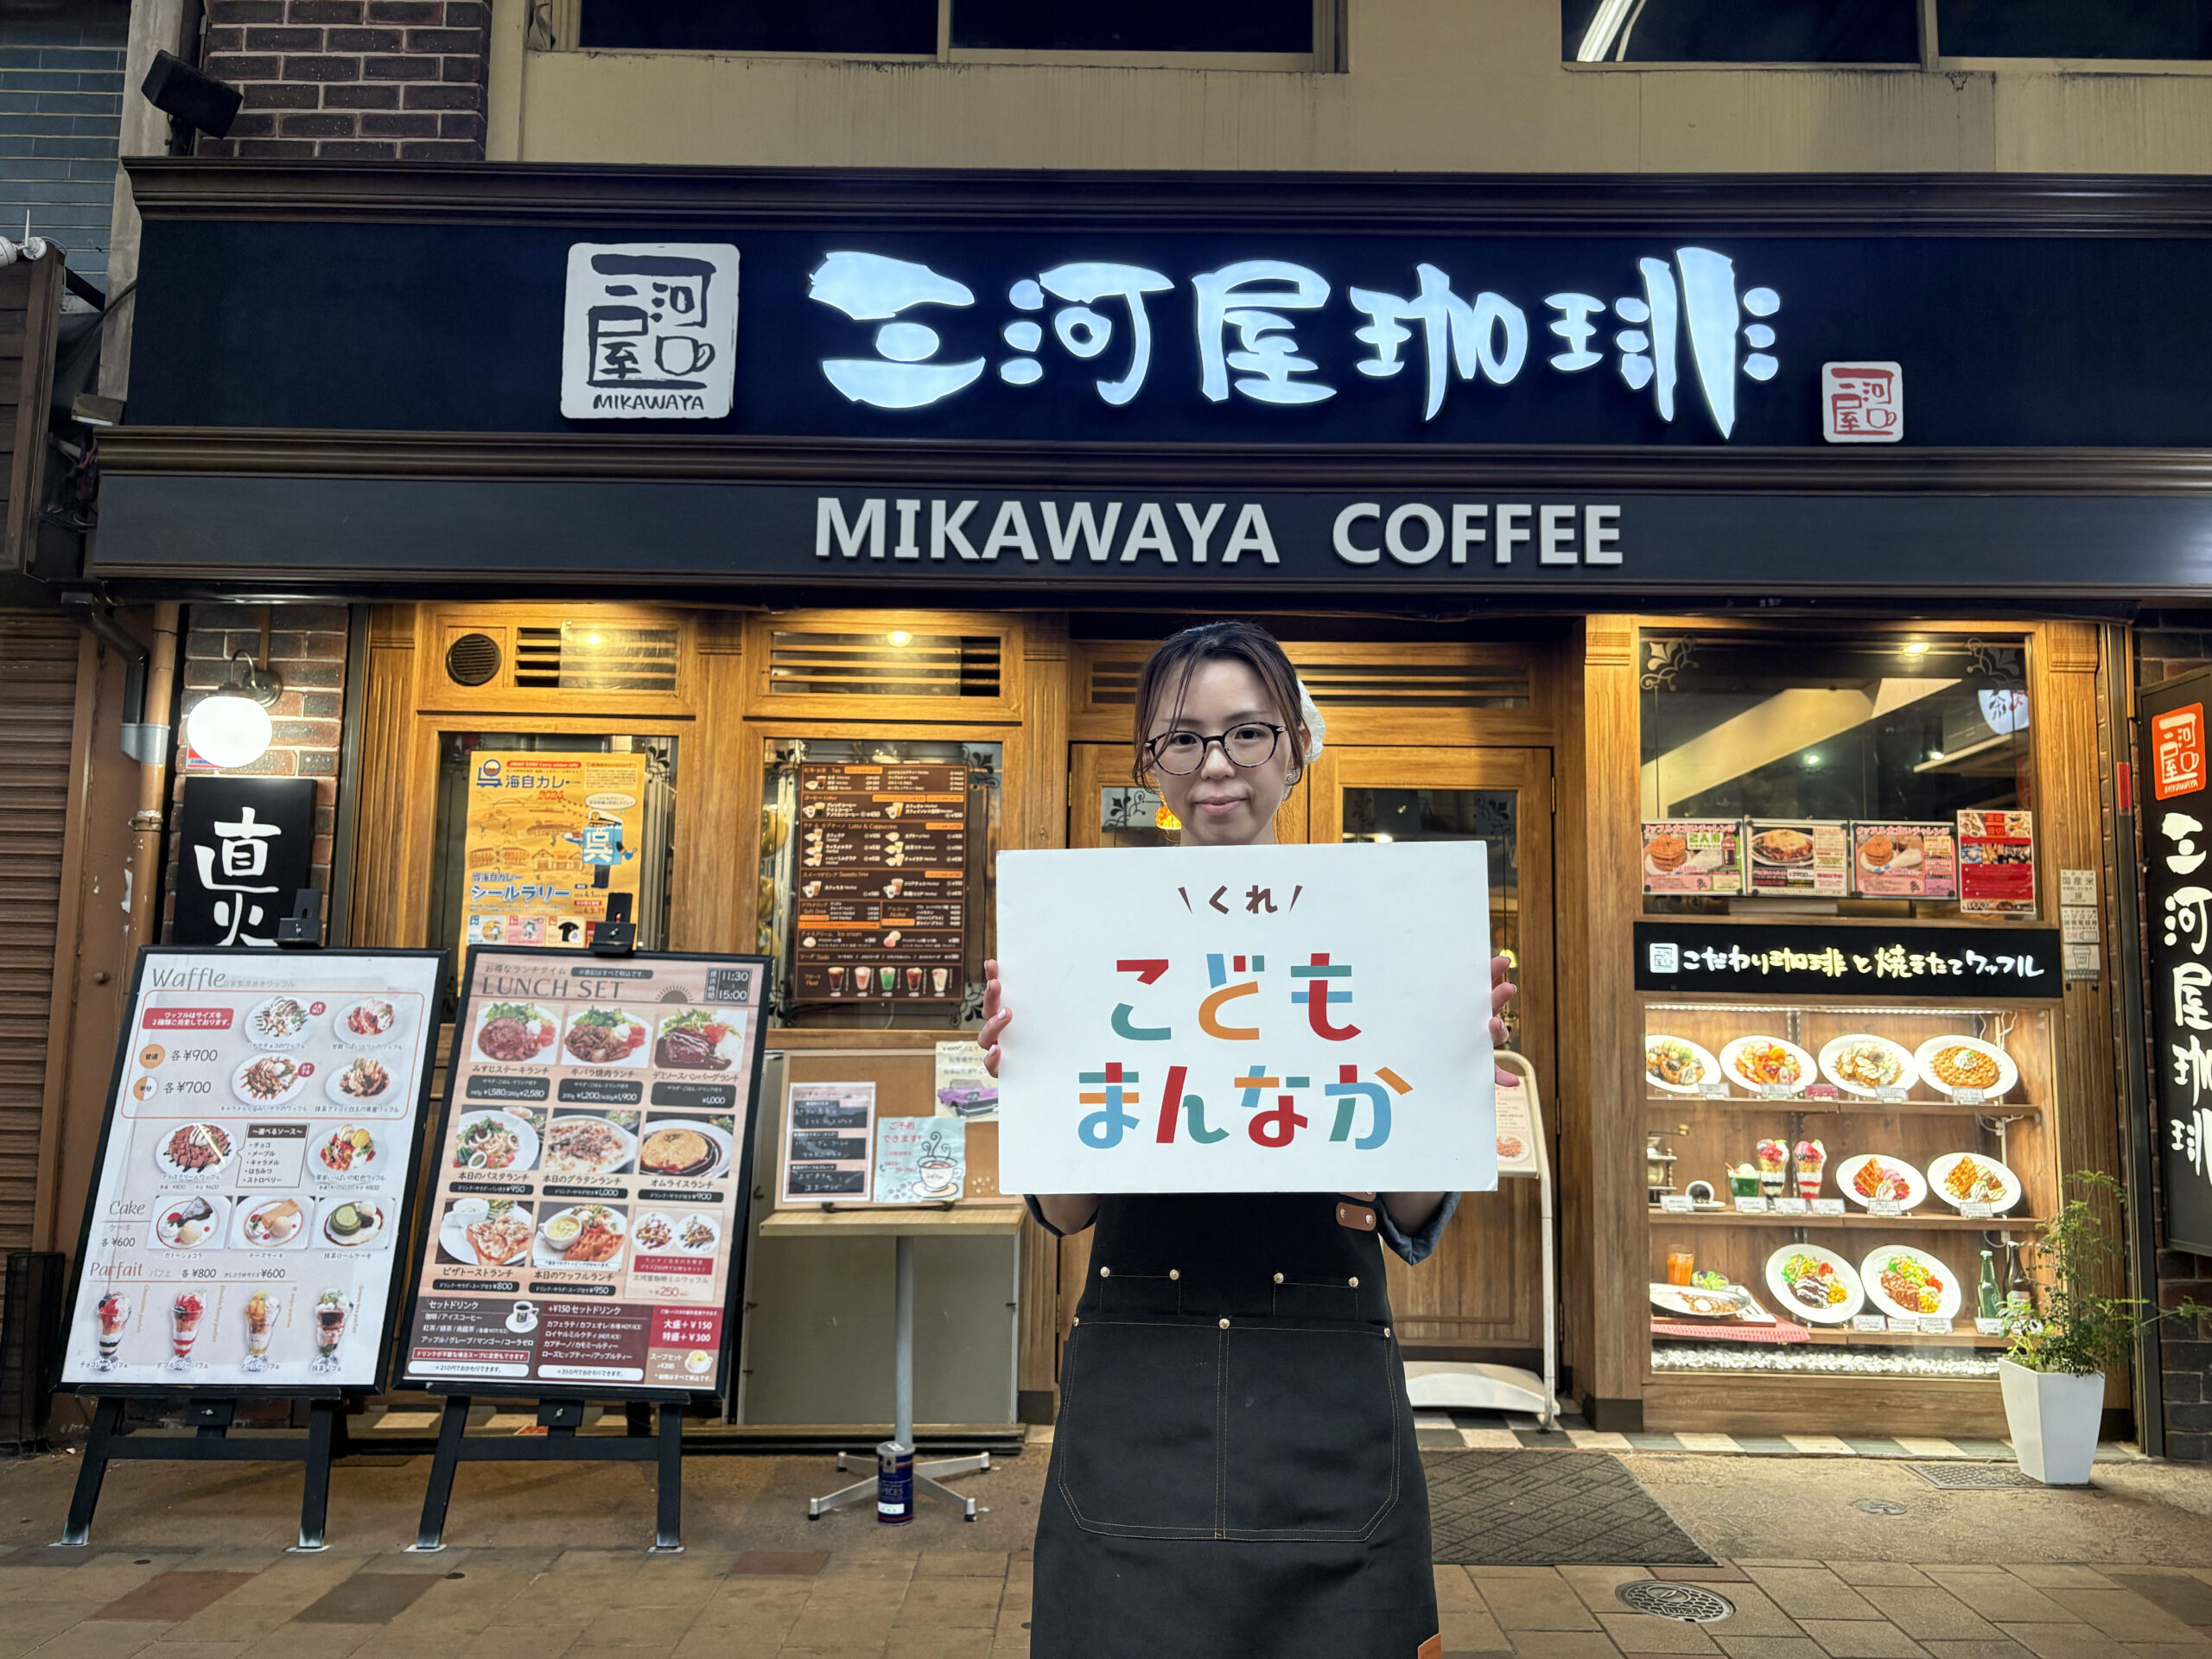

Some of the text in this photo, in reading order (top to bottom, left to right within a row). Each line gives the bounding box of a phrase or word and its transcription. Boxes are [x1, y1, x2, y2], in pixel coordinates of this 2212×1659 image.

[808, 246, 1782, 440] 三河屋珈琲
[593, 393, 705, 412] MIKAWAYA
[815, 496, 1624, 567] MIKAWAYA COFFEE
[469, 884, 571, 903] シールラリー
[152, 967, 226, 991] Waffle
[721, 970, 748, 982] 11:30
[482, 976, 625, 1000] LUNCH SET
[718, 989, 747, 1001] 15:00
[1110, 952, 1363, 1041] こども
[1077, 1062, 1414, 1150] まんなか
[458, 1171, 530, 1182] 本日のパスタランチ
[543, 1174, 622, 1185] 本日のグラタンランチ
[651, 1179, 715, 1189] オムライスランチ
[110, 1200, 145, 1215] Cake
[90, 1262, 143, 1280] Parfait
[442, 1267, 513, 1278] ピザトーストランチ
[534, 1270, 614, 1281] 本日のワッフルランチ
[429, 1300, 479, 1310] セットドリンク
